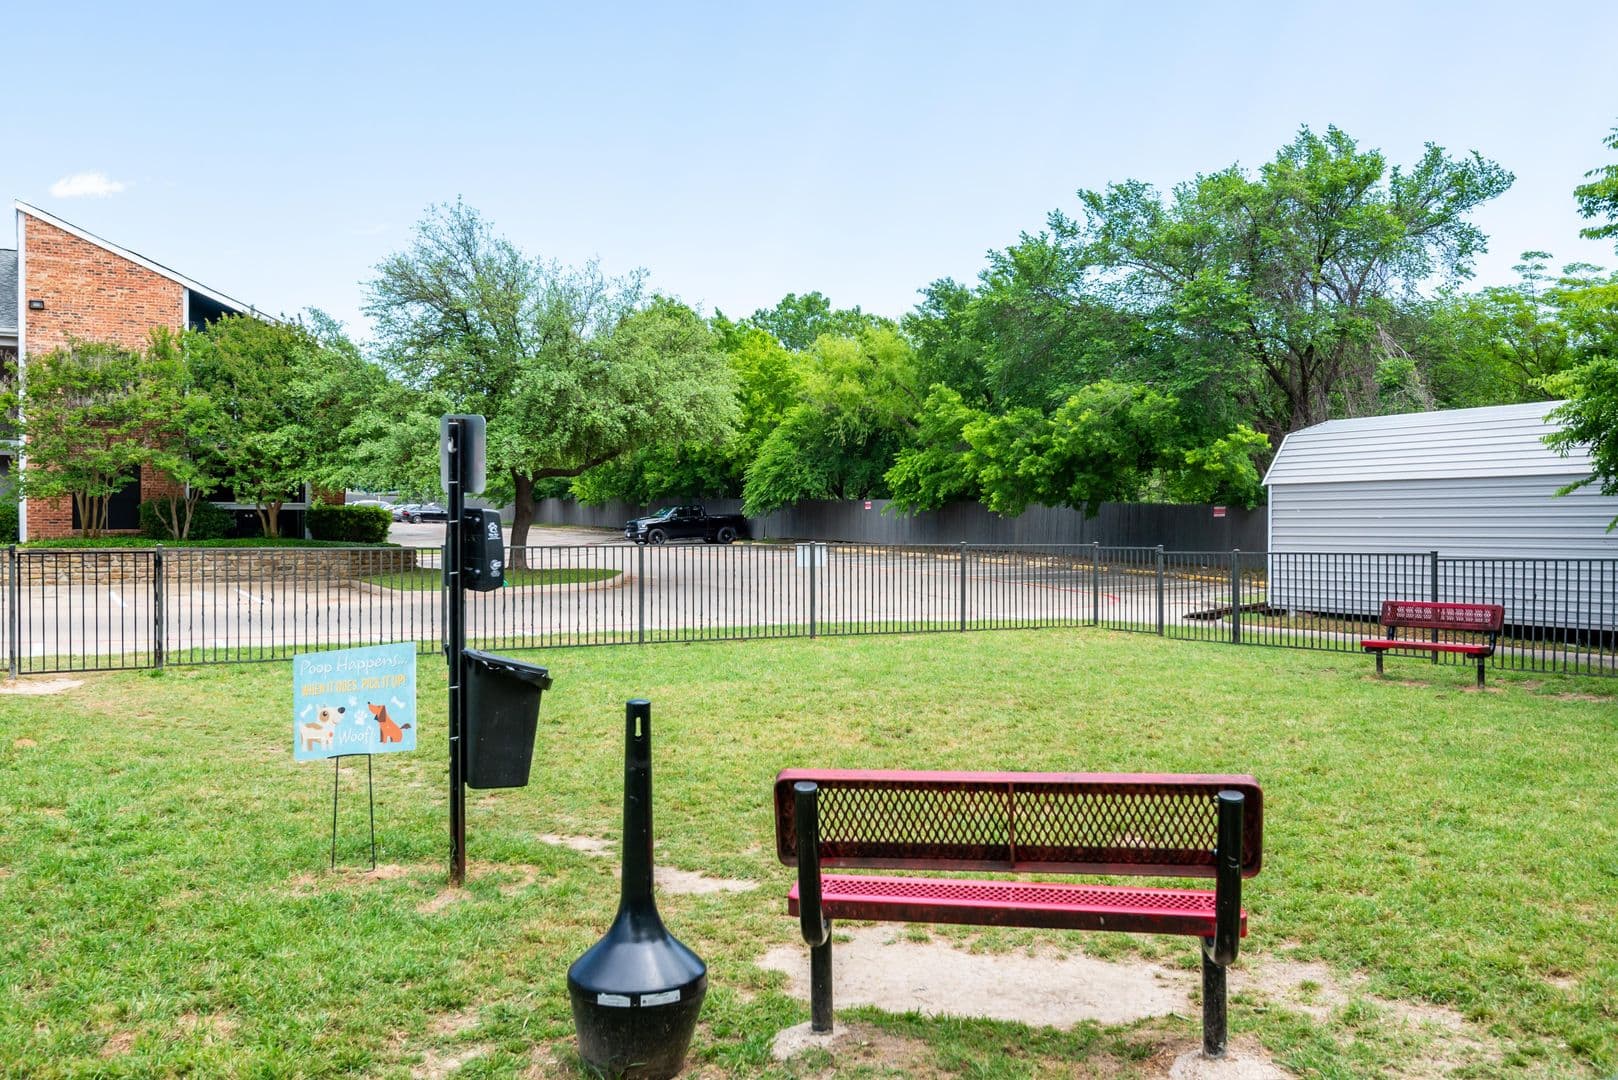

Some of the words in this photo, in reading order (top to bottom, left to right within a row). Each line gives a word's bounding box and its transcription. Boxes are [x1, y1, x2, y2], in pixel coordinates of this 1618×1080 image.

[300, 659, 333, 679] Poop
[302, 682, 326, 697] WHEN
[328, 681, 336, 693] IT
[362, 677, 380, 689] PICK
[382, 675, 390, 688] IT
